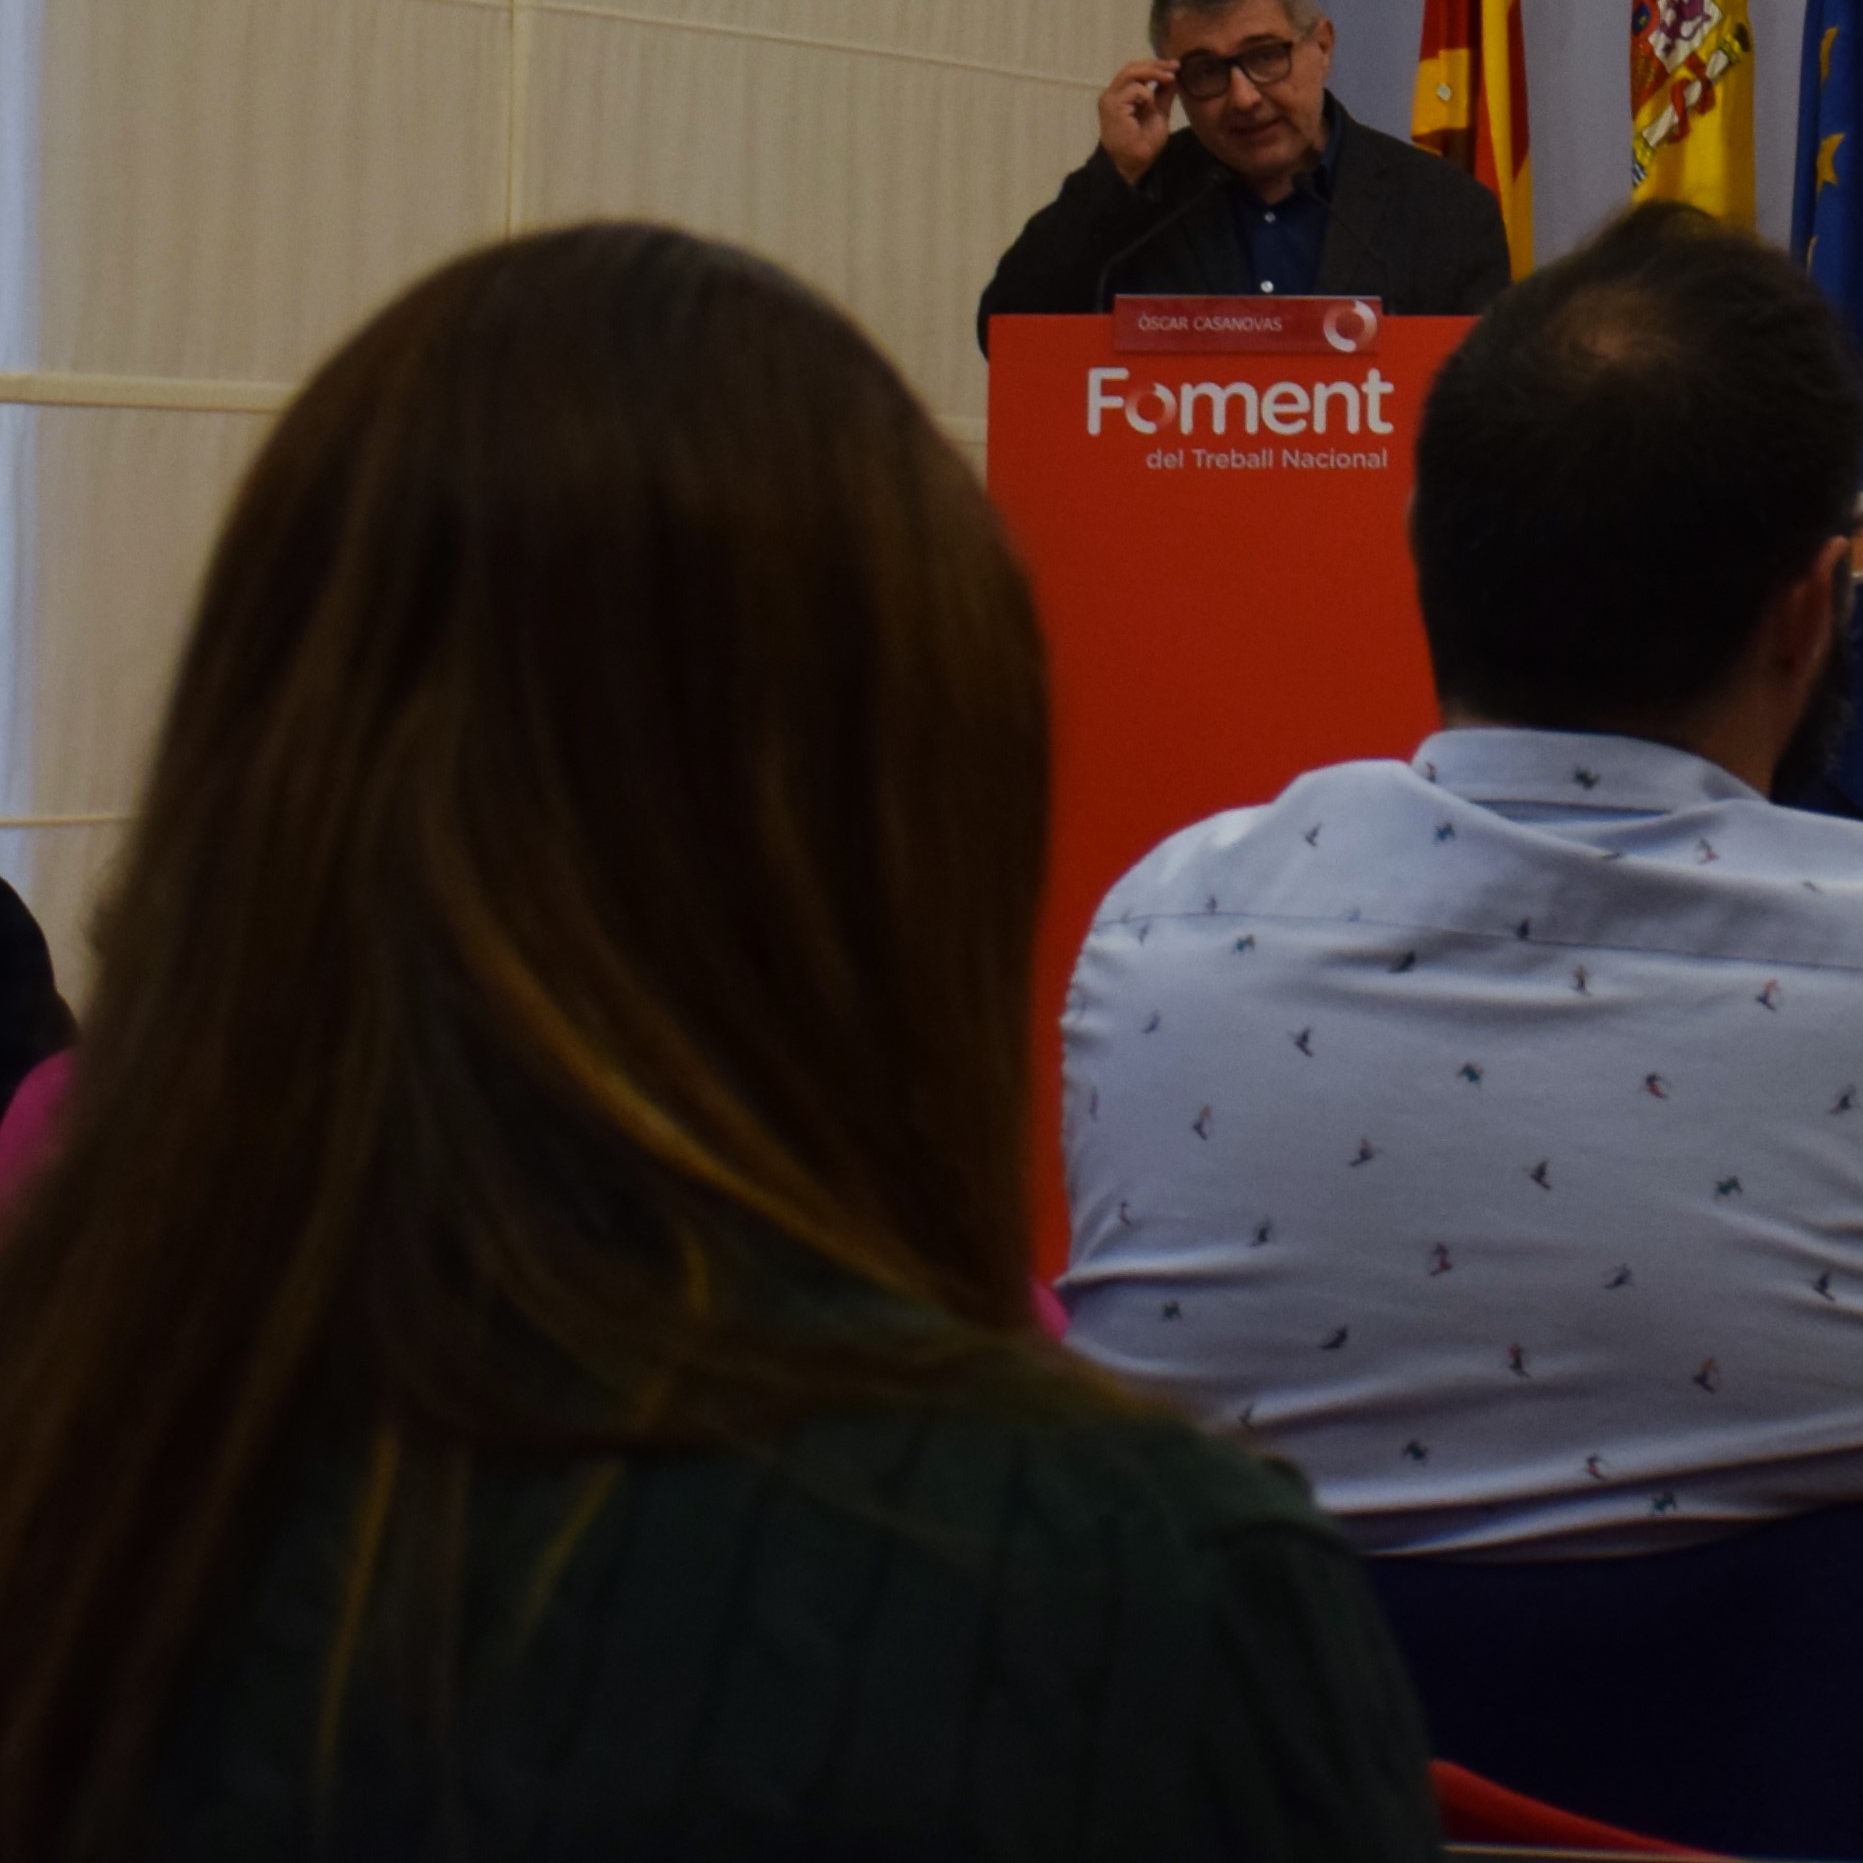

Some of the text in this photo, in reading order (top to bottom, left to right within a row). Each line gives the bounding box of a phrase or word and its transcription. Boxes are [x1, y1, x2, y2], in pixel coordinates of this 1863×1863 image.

[1193, 316, 1283, 332] CASANOVAS
[1086, 367, 1395, 436] Foment
[1146, 448, 1388, 470] del Treball Nacional
